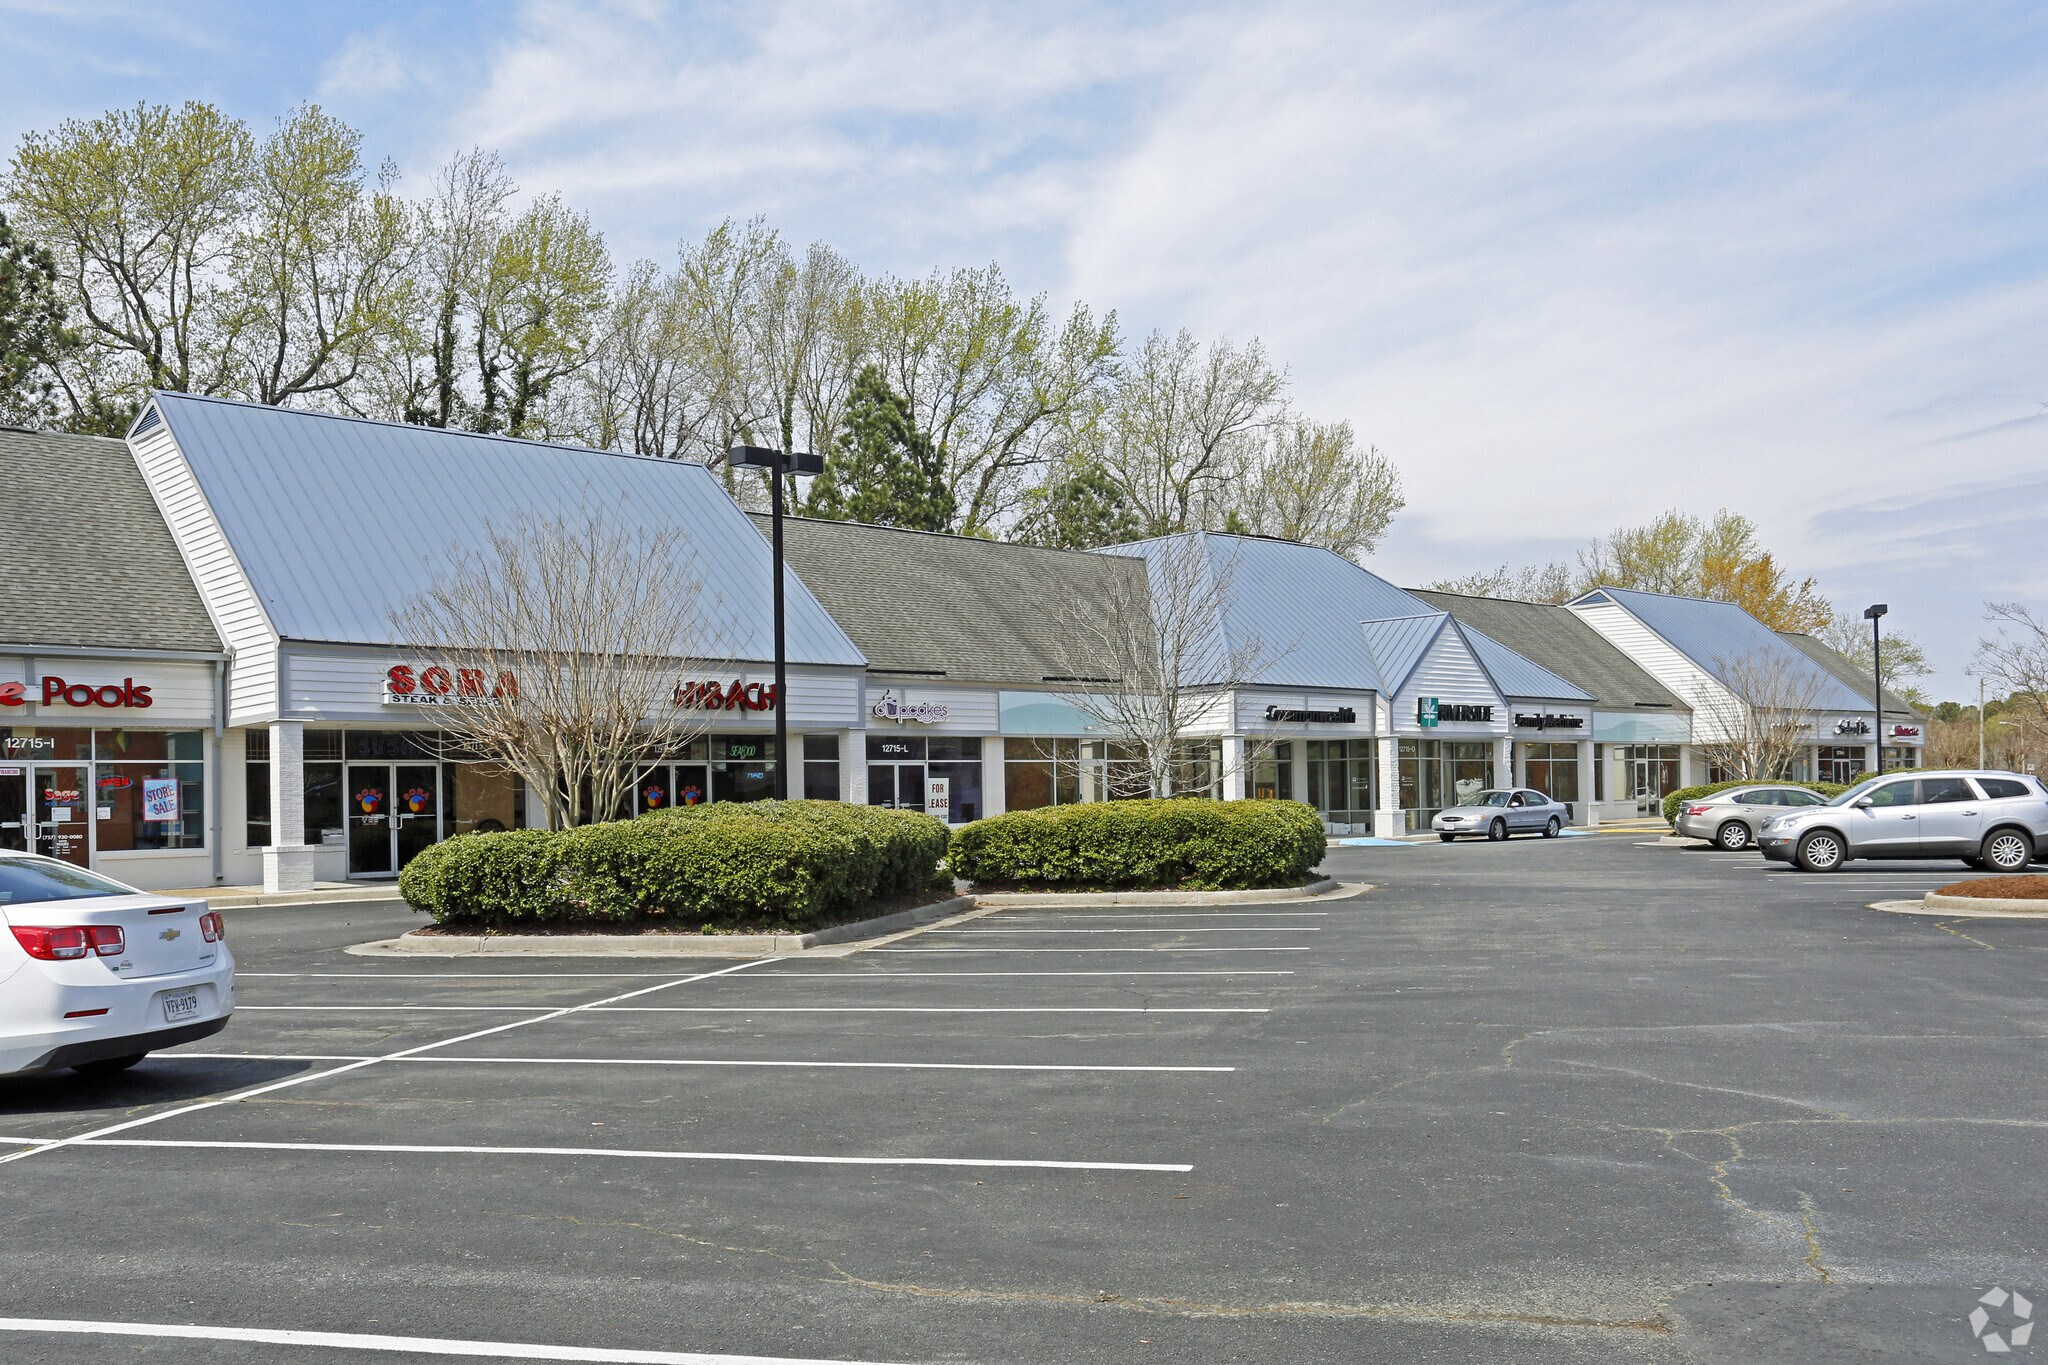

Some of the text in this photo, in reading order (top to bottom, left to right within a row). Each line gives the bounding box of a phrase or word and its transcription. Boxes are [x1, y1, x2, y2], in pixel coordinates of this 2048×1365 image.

[388, 665, 519, 697] SORA
[42, 676, 153, 709] Pools
[392, 694, 438, 704] STEAK
[1264, 705, 1356, 723] Commonwealth
[1438, 704, 1495, 722] RIVERSIDE
[1514, 713, 1584, 731] Family Medicine
[730, 744, 756, 759] SEAFOOD
[97, 777, 130, 787] OPEN
[931, 783, 945, 793] FOR
[44, 788, 80, 802] Sage
[146, 784, 175, 802] STORE
[153, 800, 176, 815] SALE
